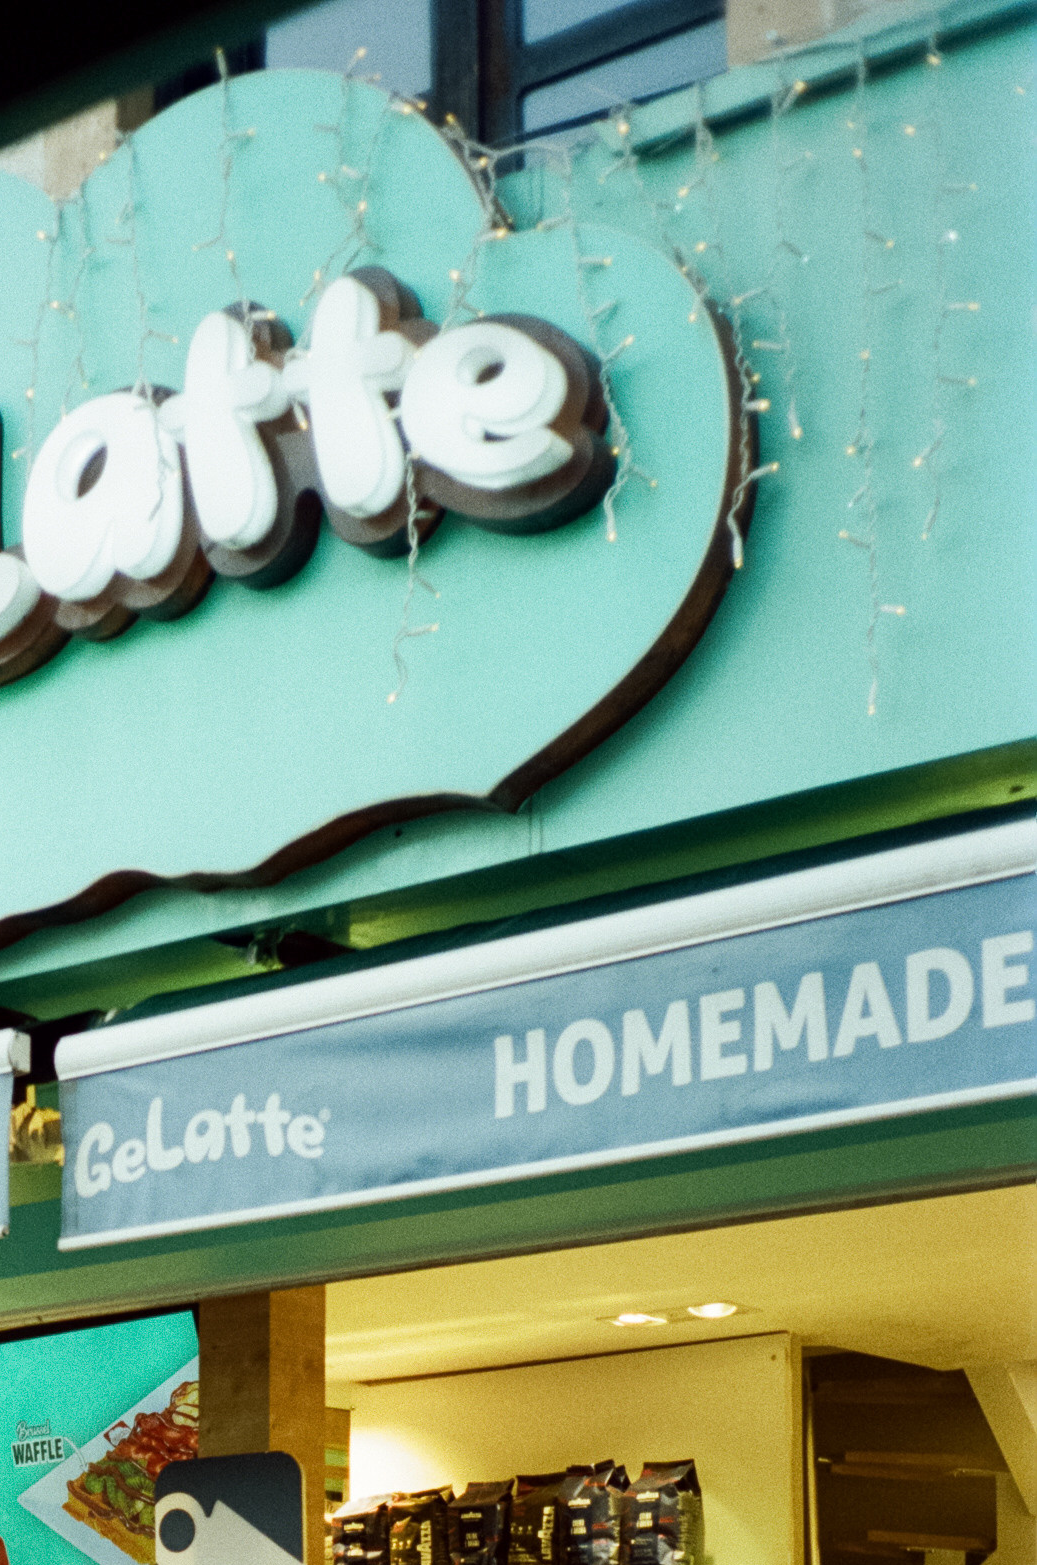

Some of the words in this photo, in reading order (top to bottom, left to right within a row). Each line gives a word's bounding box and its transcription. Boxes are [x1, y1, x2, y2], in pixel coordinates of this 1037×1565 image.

[493, 929, 1036, 1119] HOMEMADE
[74, 1093, 327, 1198] GeLatte
[12, 1437, 63, 1466] WAFFLE
